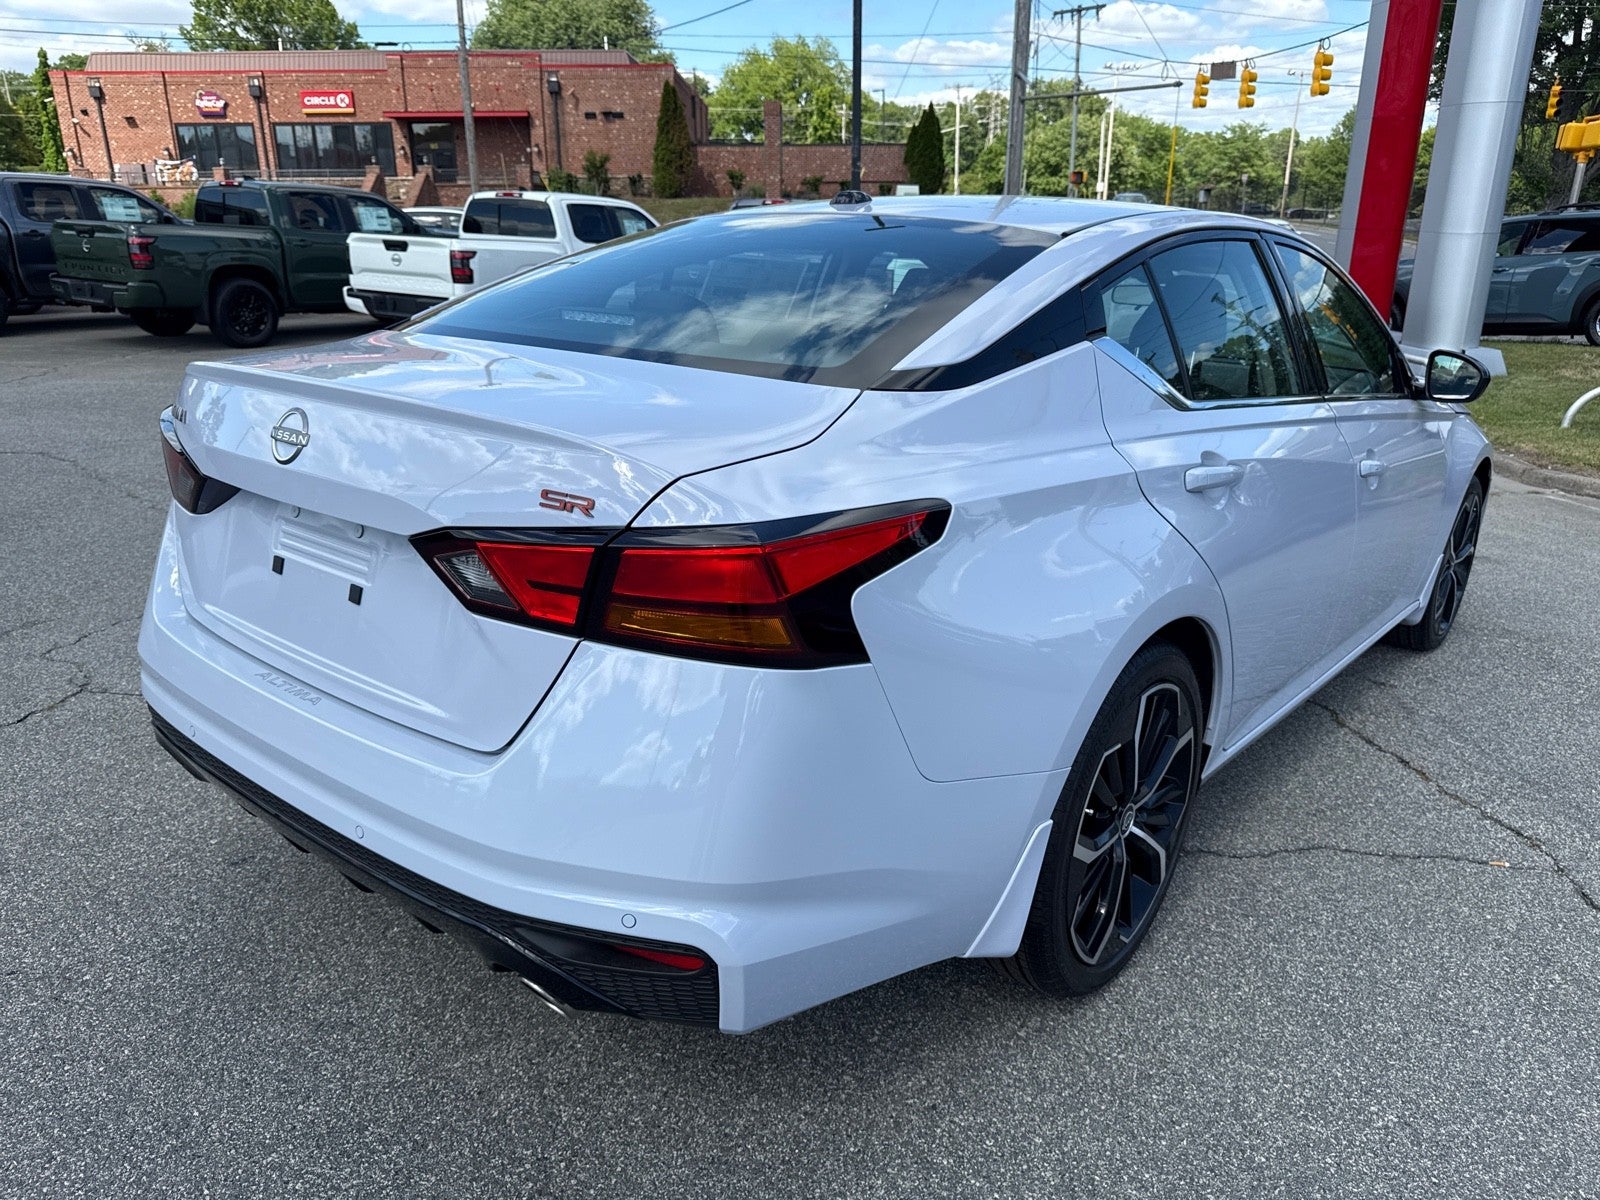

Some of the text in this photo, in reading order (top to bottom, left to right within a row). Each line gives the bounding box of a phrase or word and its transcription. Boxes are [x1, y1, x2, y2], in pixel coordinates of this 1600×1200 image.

[303, 95, 336, 106] CIRCLE
[539, 489, 595, 518] SR
[254, 672, 322, 706] ALTIMA
